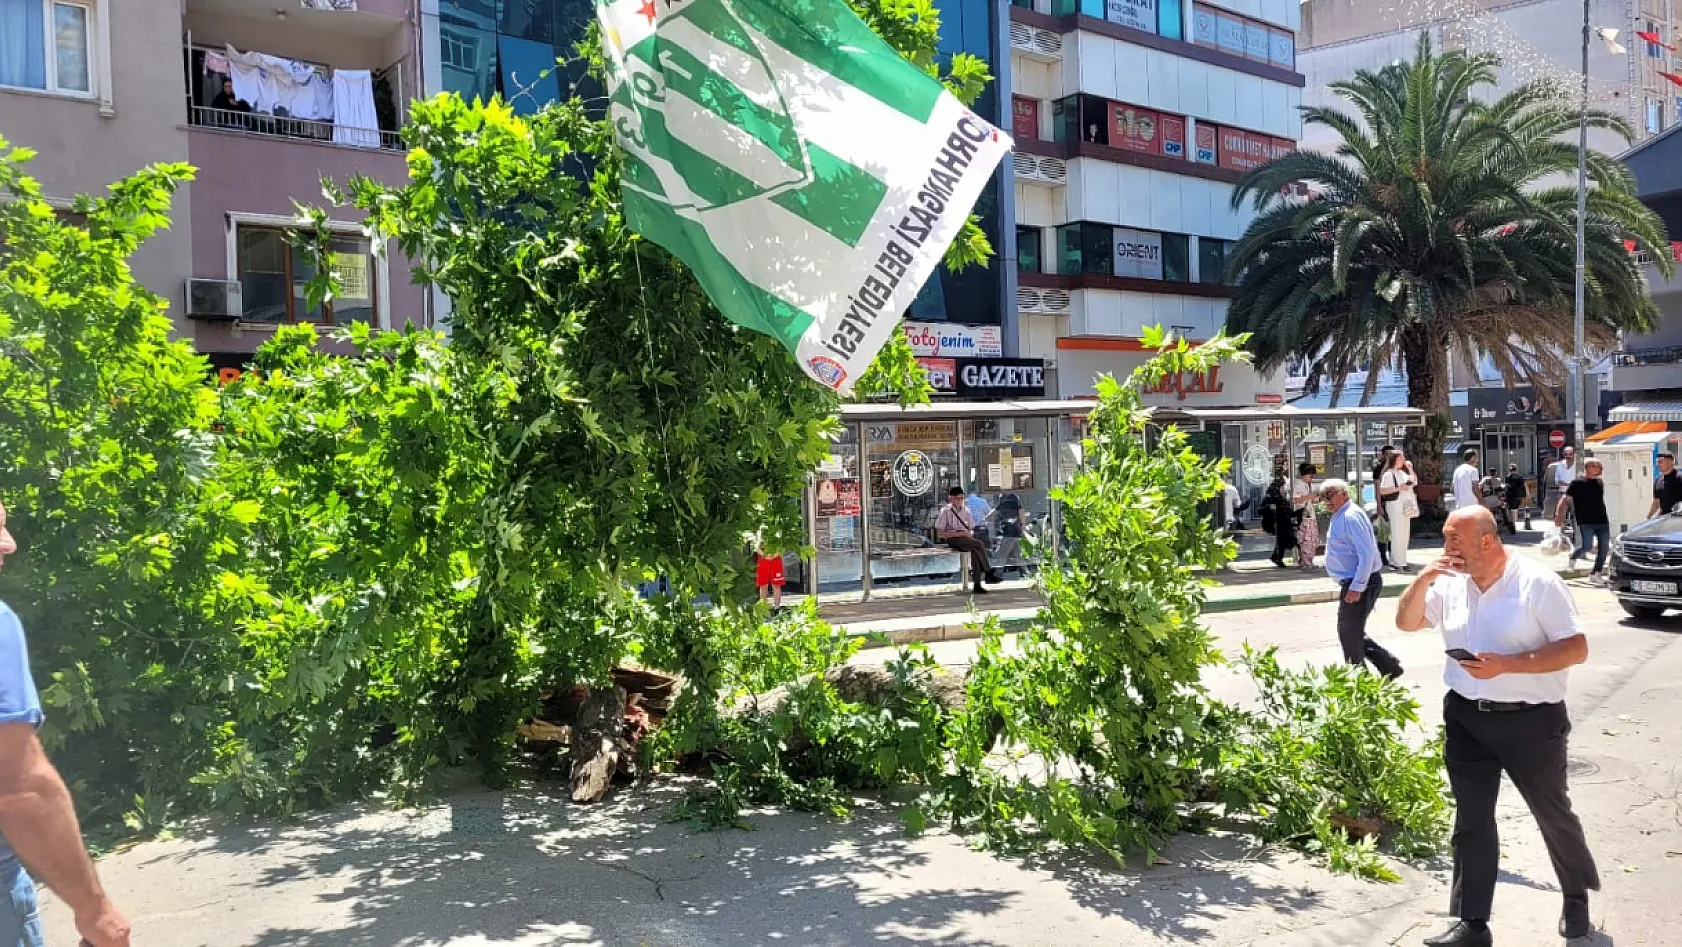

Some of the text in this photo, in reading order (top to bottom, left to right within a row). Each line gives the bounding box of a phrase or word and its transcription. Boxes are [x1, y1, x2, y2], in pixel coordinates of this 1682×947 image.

[1165, 142, 1182, 153] CHP
[904, 326, 975, 357] Fotojenim
[961, 364, 1045, 388] GAZETE
